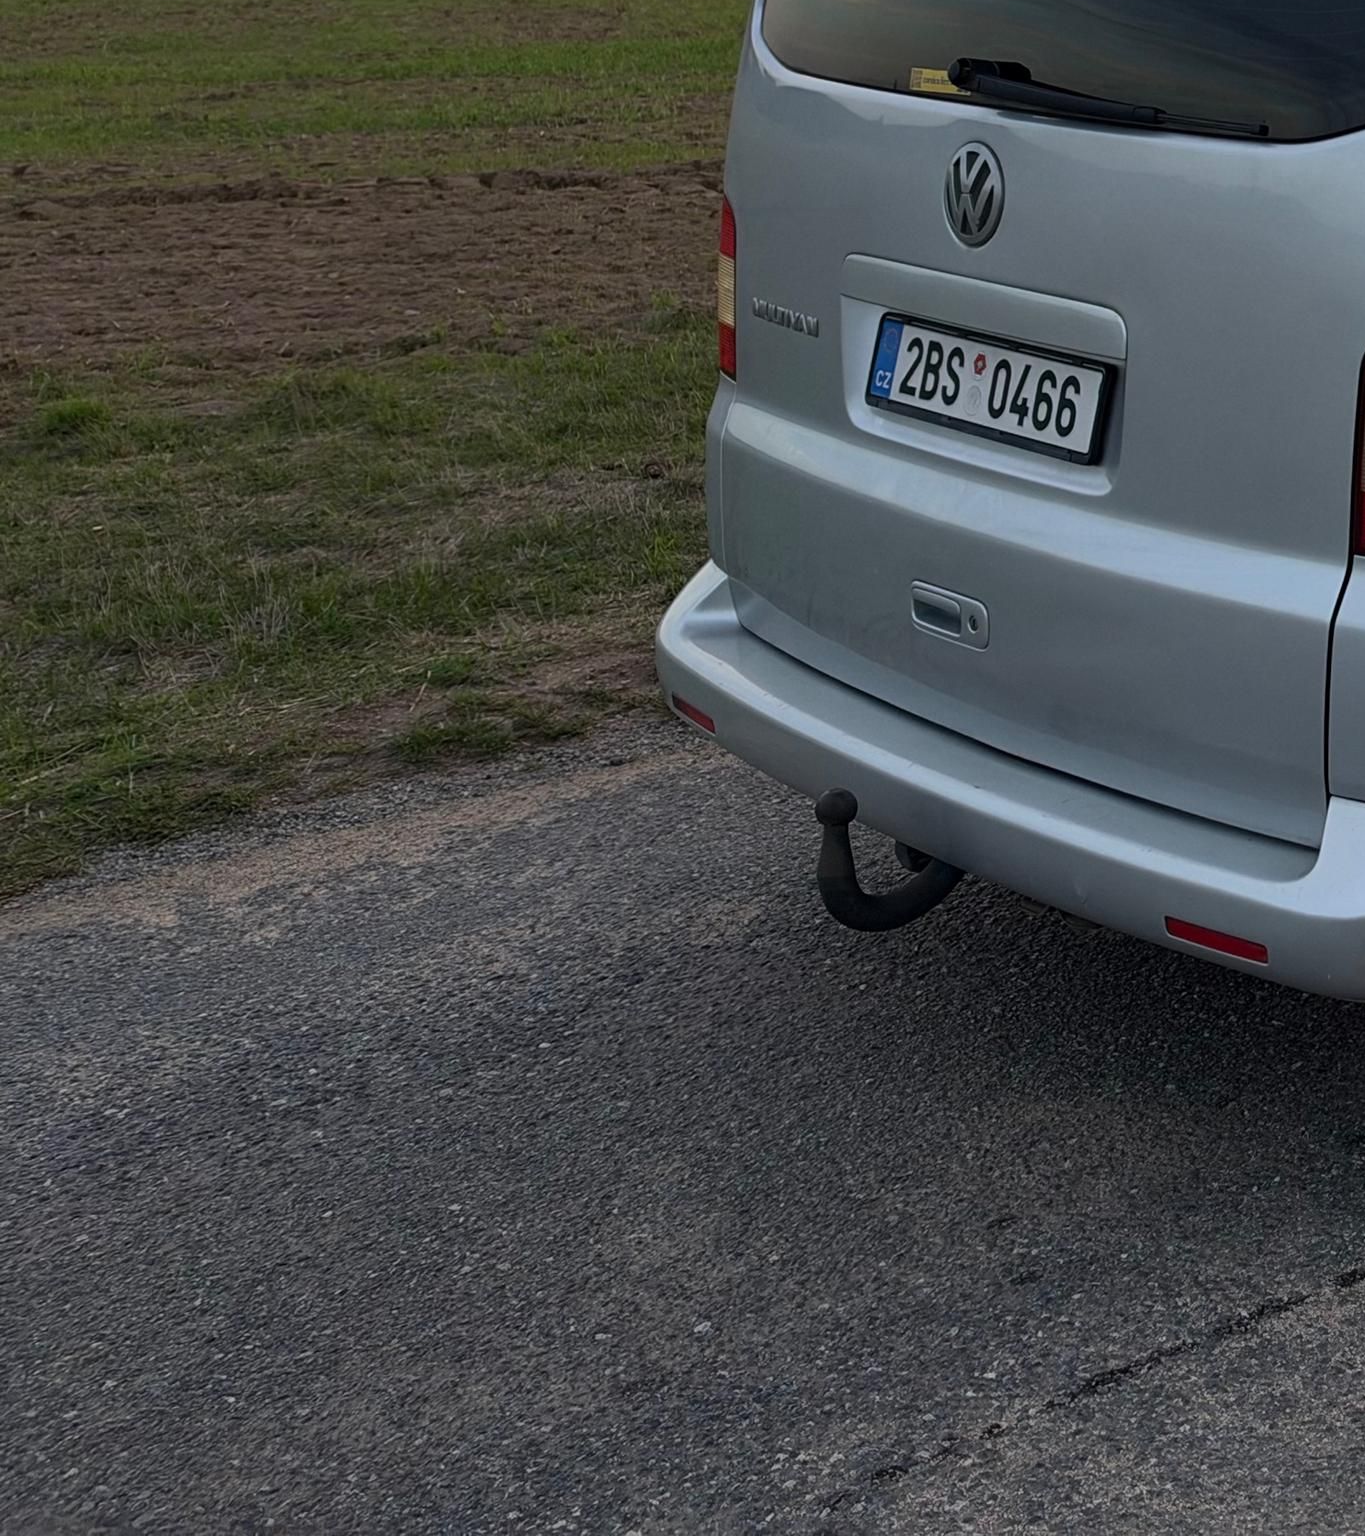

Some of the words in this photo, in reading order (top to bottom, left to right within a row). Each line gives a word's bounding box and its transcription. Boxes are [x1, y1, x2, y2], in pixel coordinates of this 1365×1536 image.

[875, 369, 892, 390] CZ
[899, 336, 965, 406] 2BS
[988, 358, 1081, 438] 0466
